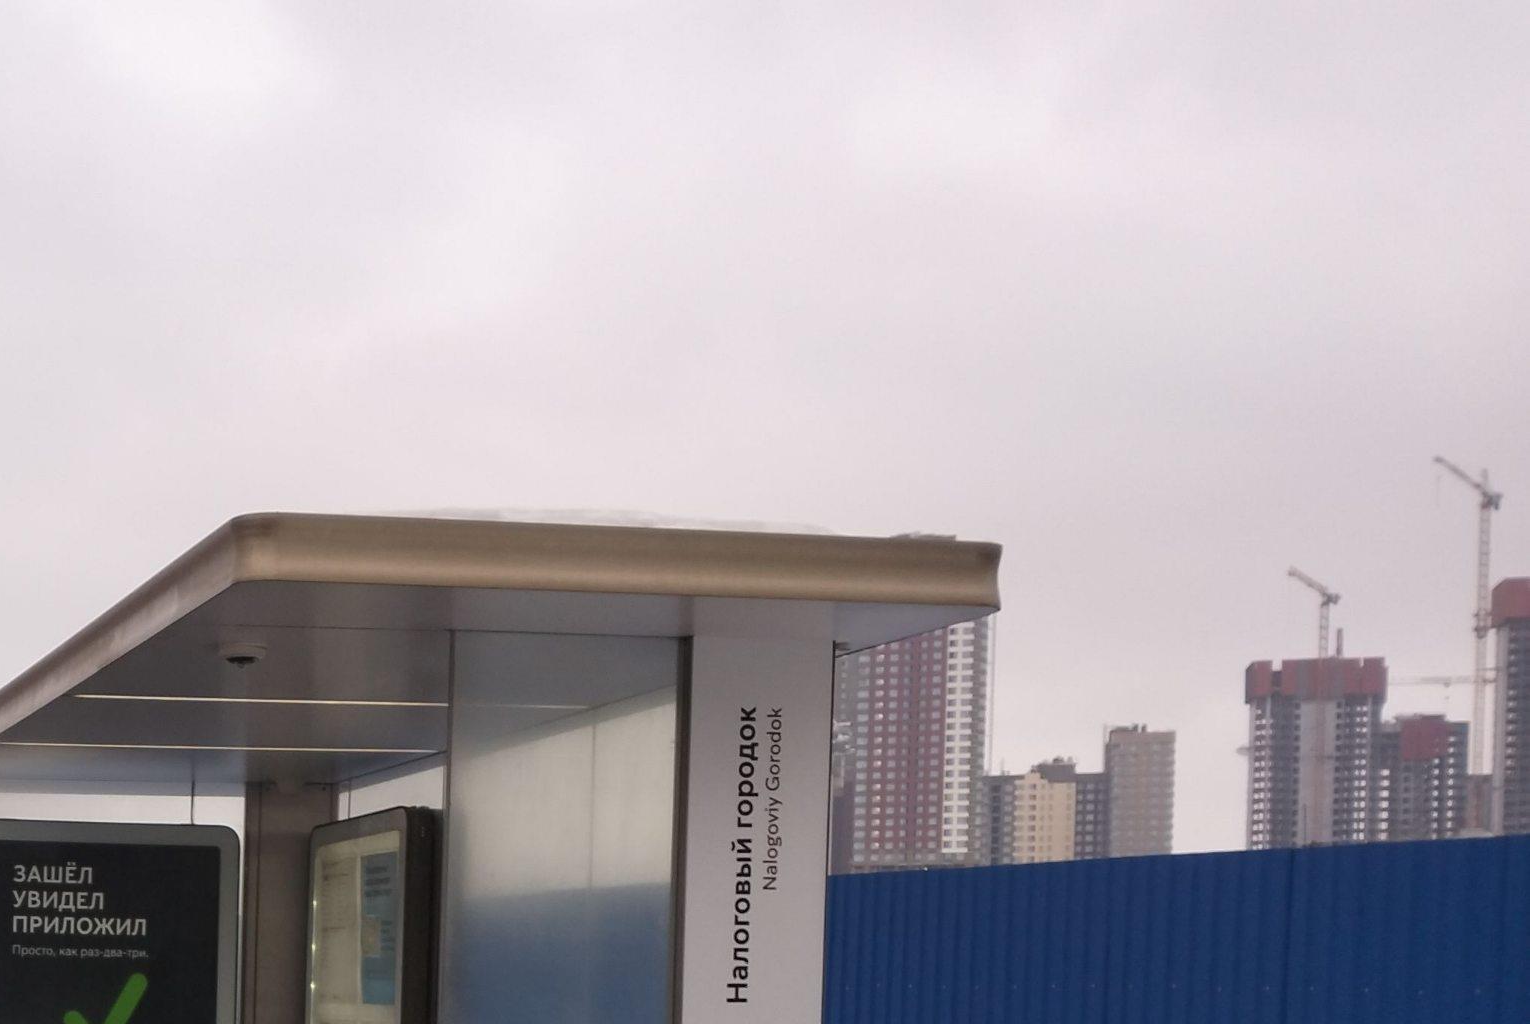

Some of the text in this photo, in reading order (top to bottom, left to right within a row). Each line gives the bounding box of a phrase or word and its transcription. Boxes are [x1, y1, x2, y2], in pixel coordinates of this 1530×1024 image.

[763, 708, 783, 890] Nalogoviy Gorodok
[726, 707, 759, 1003] Налоговый городок
[13, 861, 93, 884] ЗАШЁЛ
[13, 890, 104, 912] УВИДЕЛ
[12, 915, 147, 936] ПРИЛОЖИЛ
[12, 944, 56, 957] Просто,
[59, 947, 79, 956] как
